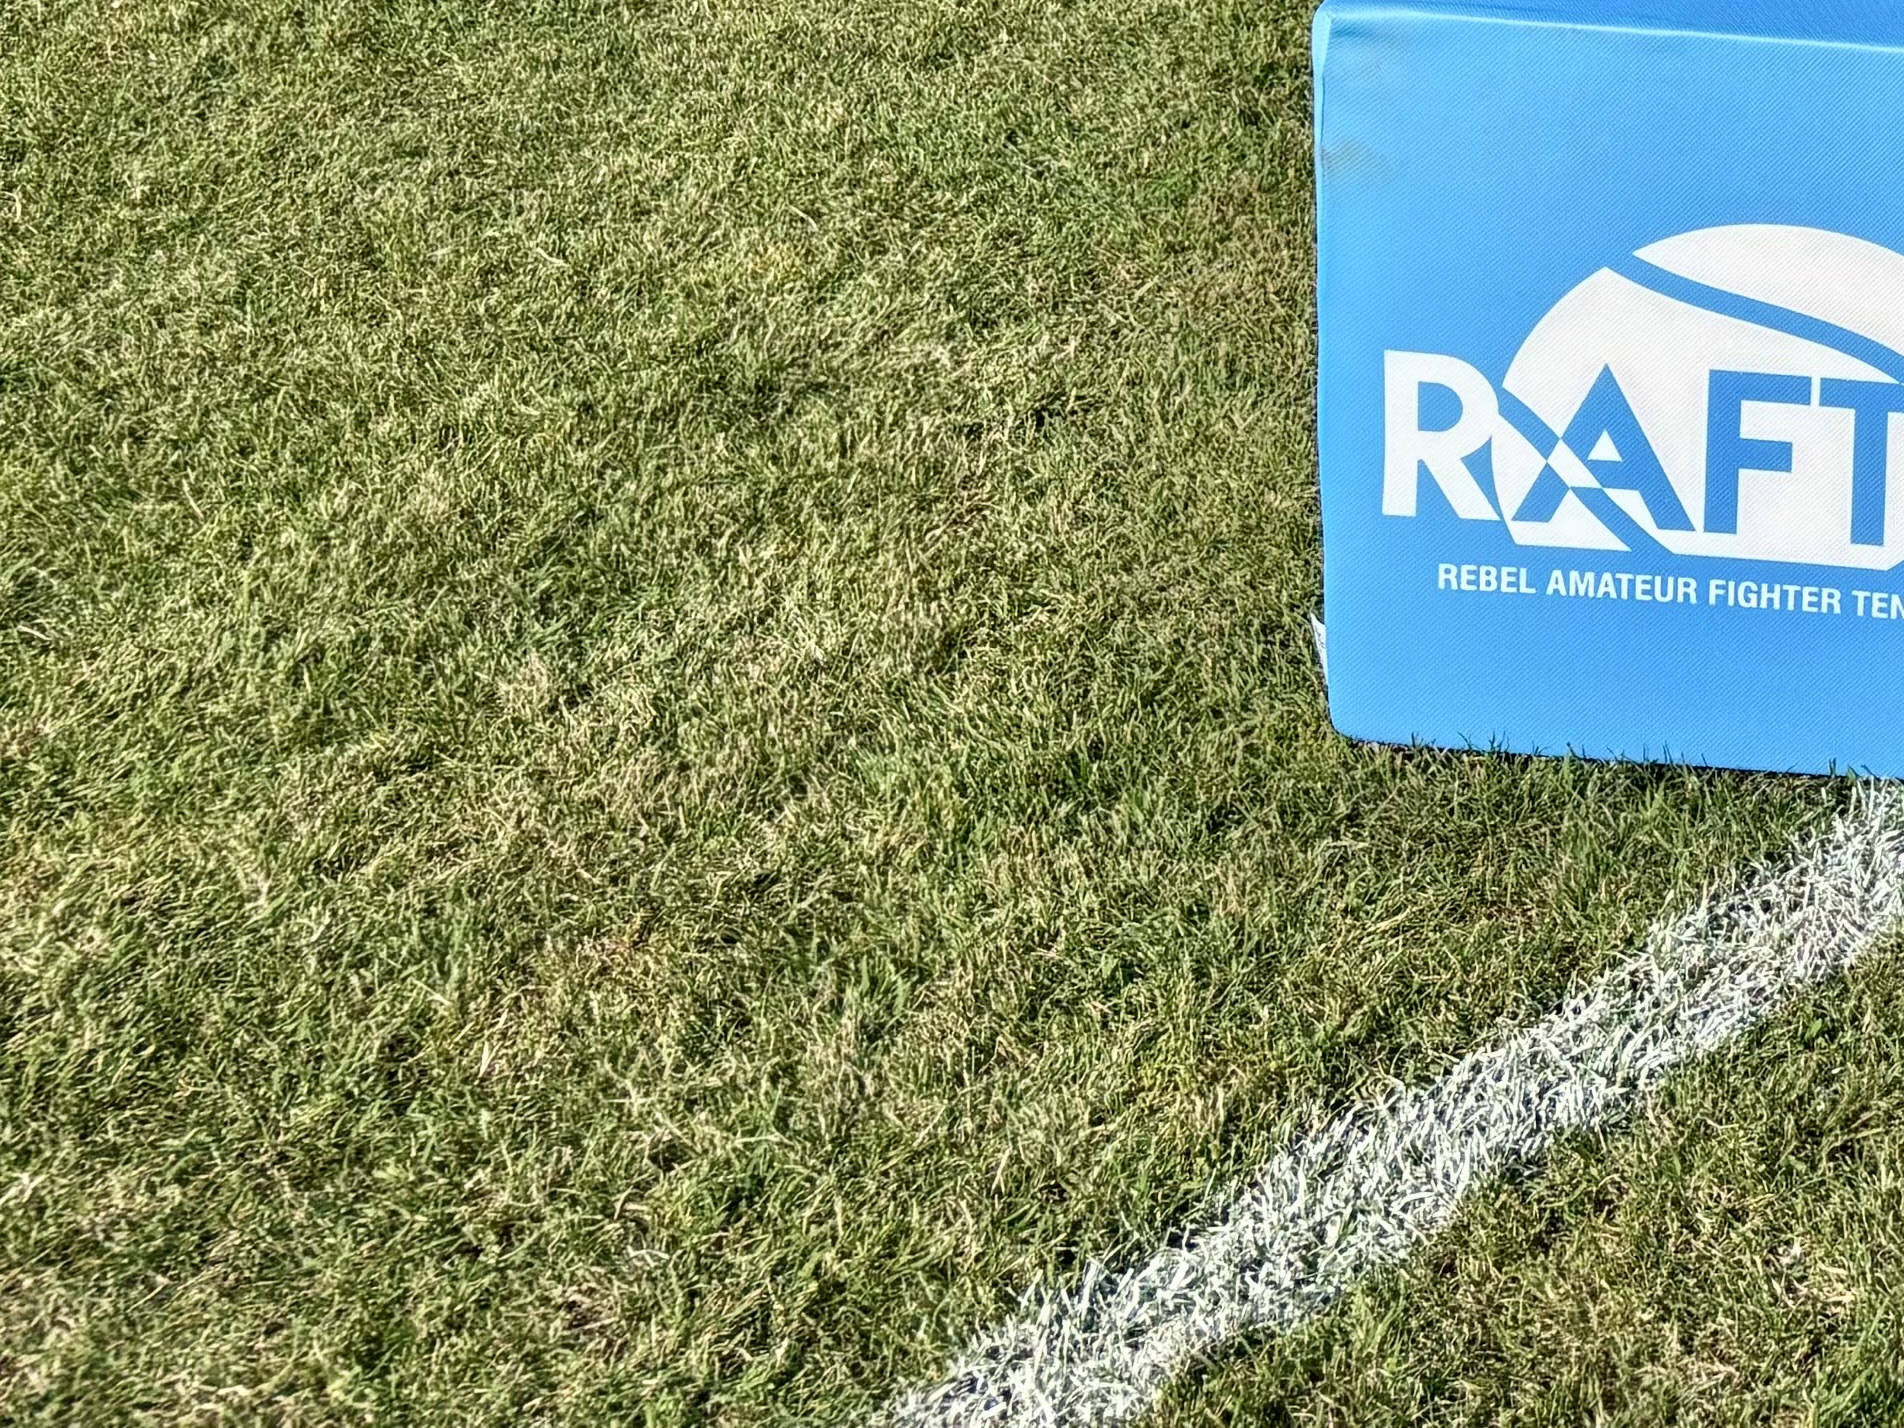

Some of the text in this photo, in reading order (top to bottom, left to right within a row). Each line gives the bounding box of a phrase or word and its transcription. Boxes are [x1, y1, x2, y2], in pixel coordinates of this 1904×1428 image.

[1437, 562, 1535, 595] REBEL
[1546, 569, 1698, 604] AMATEUR
[1707, 578, 1843, 615] FIGHTER
